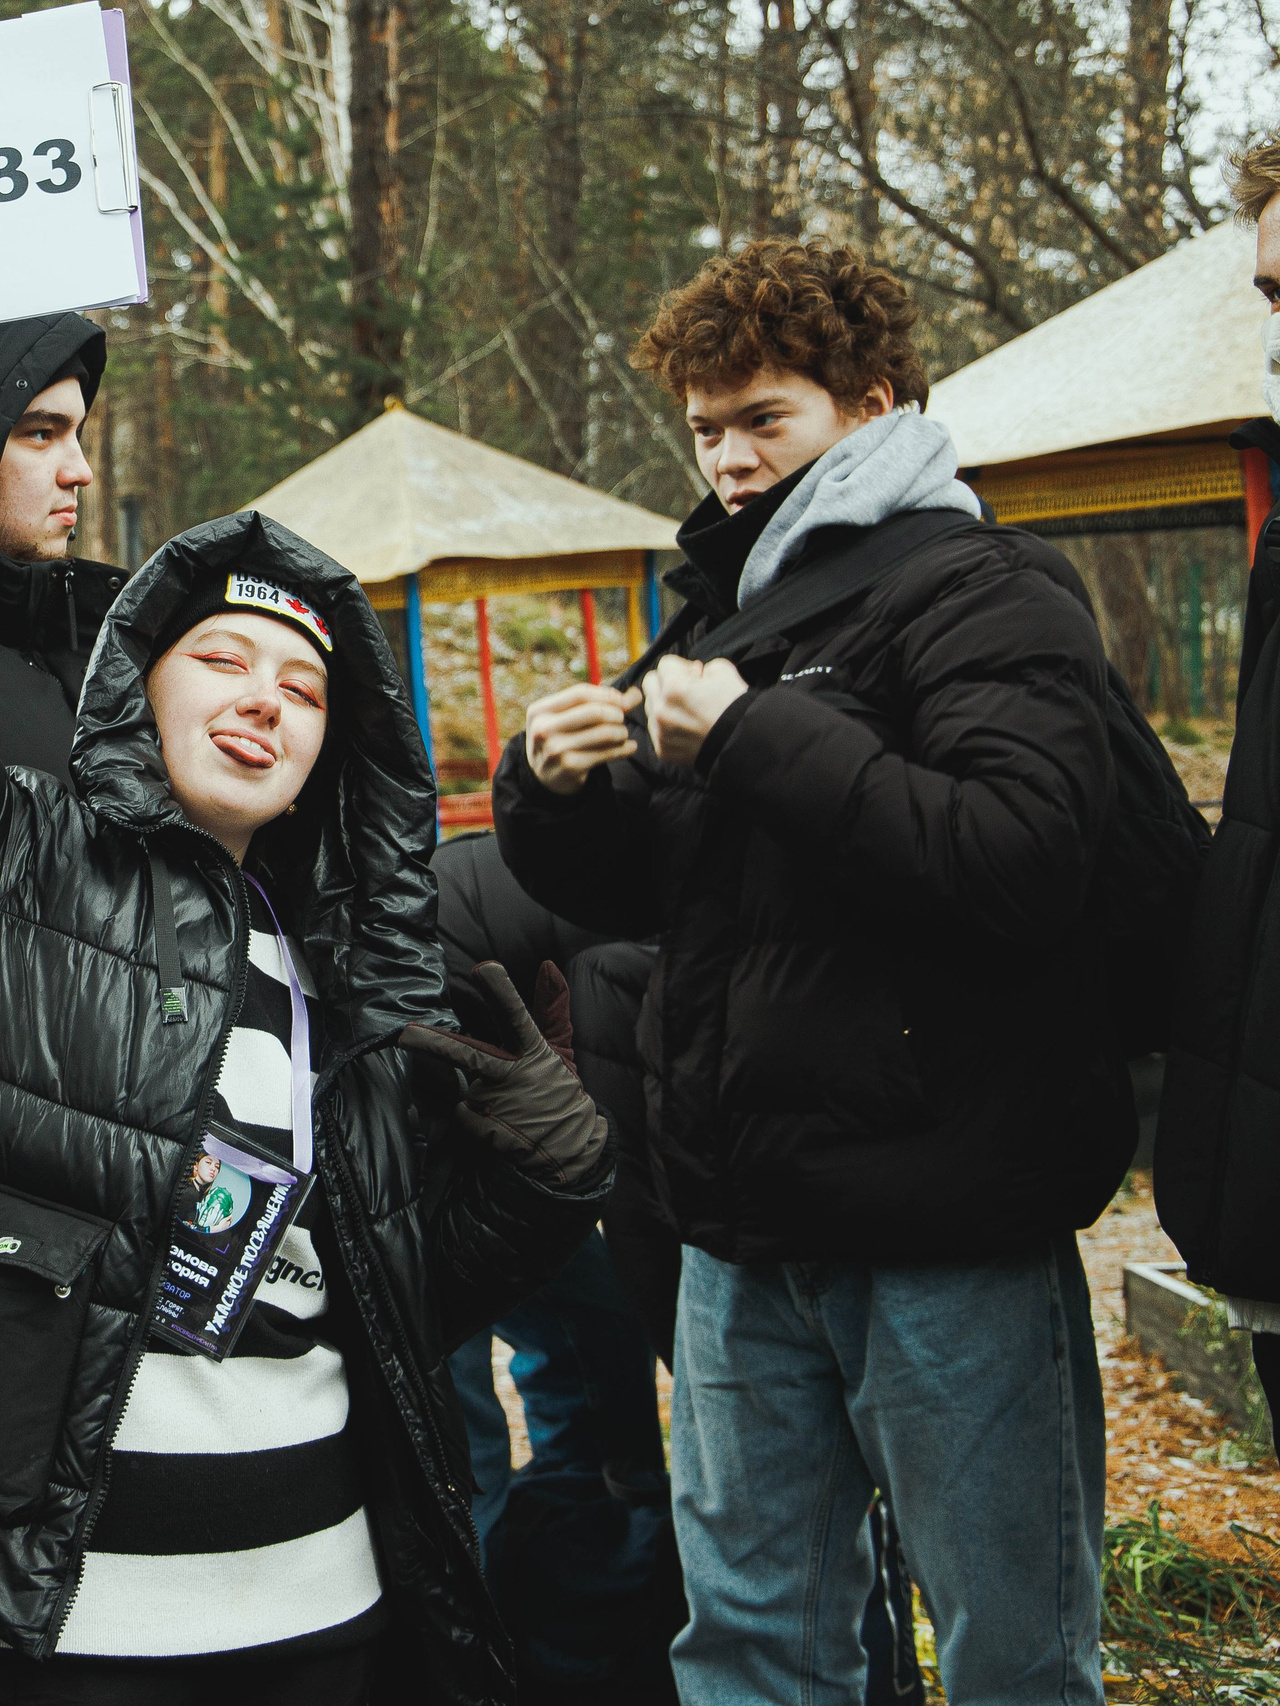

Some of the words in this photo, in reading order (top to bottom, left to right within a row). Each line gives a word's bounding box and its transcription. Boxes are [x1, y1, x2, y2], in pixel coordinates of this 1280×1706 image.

[236, 583, 280, 604] 1964
[168, 1259, 211, 1288] ория
[204, 1266, 249, 1336] УЖАСНОЕ
[240, 1183, 292, 1269] ПОСВЯЩЕНИ
